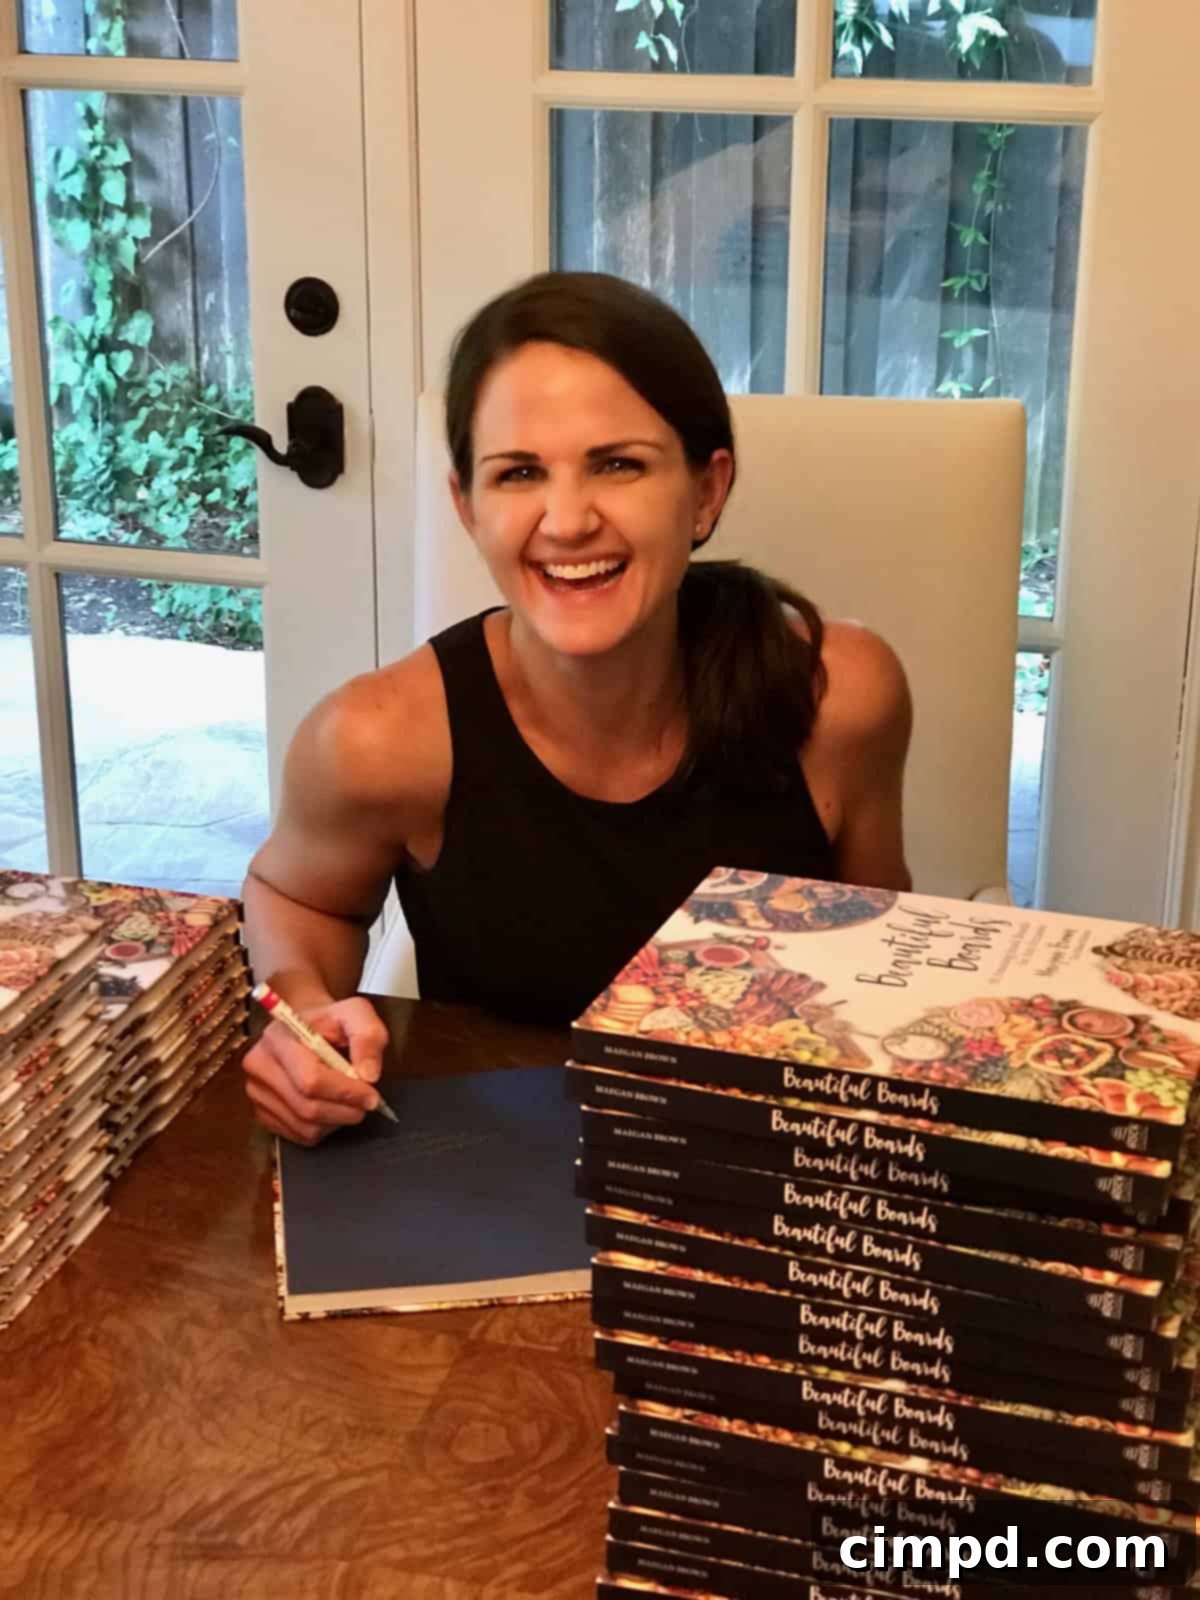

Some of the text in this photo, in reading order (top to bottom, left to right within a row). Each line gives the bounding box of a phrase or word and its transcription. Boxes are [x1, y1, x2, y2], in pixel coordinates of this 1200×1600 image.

[855, 905, 954, 988] Beautiful
[927, 916, 1012, 972] Boards
[783, 1066, 940, 1115] Beautiful Boards
[771, 1109, 926, 1162] Beautiful Boards
[794, 1146, 951, 1193] Beautiful Boards
[784, 1182, 938, 1233] Beautiful Boards
[773, 1214, 922, 1271] Beautiful Boards
[788, 1260, 940, 1315] Beautiful Boards
[800, 1303, 955, 1354] Beautiful Boards
[798, 1334, 951, 1383] Beautiful Boards
[802, 1380, 955, 1431] Beautiful Boards
[818, 1410, 968, 1461] Beautiful Boards
[823, 1458, 976, 1512] Beautiful Boards
